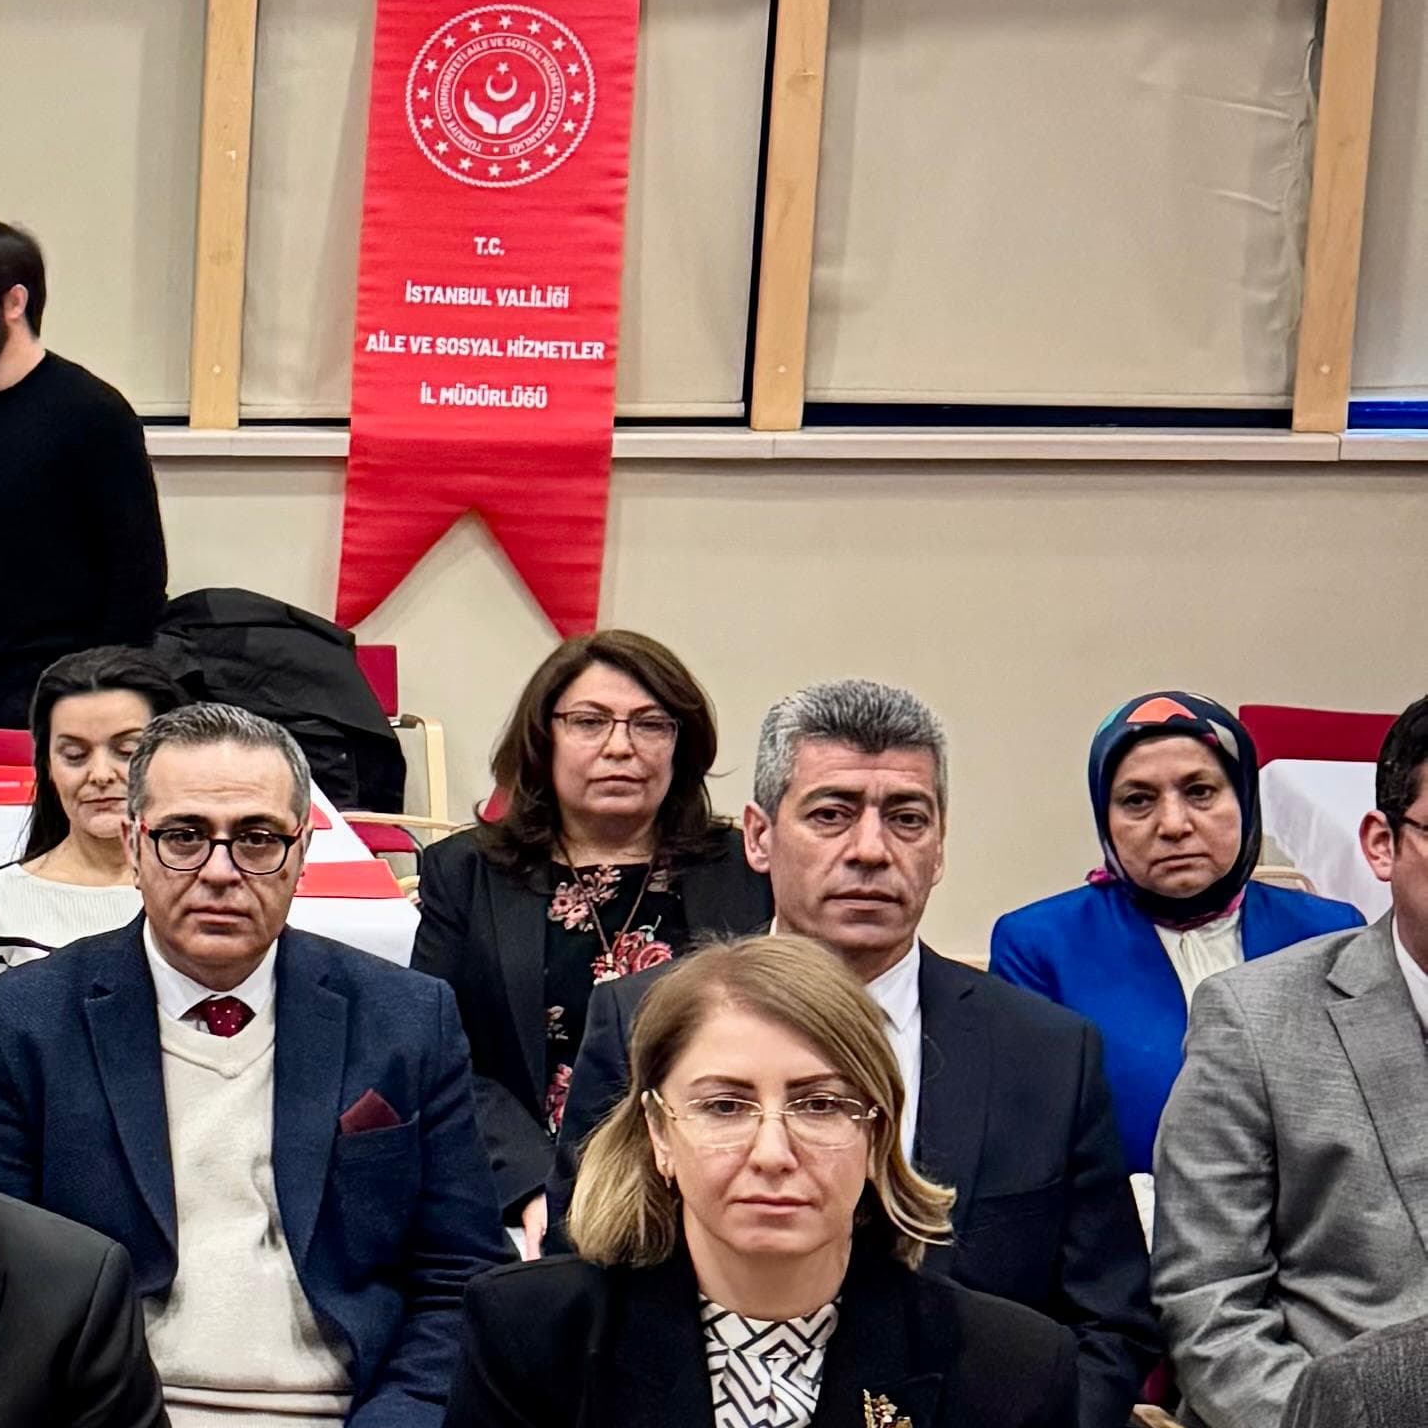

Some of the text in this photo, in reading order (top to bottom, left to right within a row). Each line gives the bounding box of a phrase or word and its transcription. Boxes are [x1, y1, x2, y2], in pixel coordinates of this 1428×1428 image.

[474, 237, 505, 255] T.C.
[405, 280, 569, 309] İSTANBUL VALİLİĞİ
[365, 330, 605, 360] AİLE VE SOSYAL HİZMETLER
[420, 382, 548, 409] İL MÜDÜRLÜĞÜ
